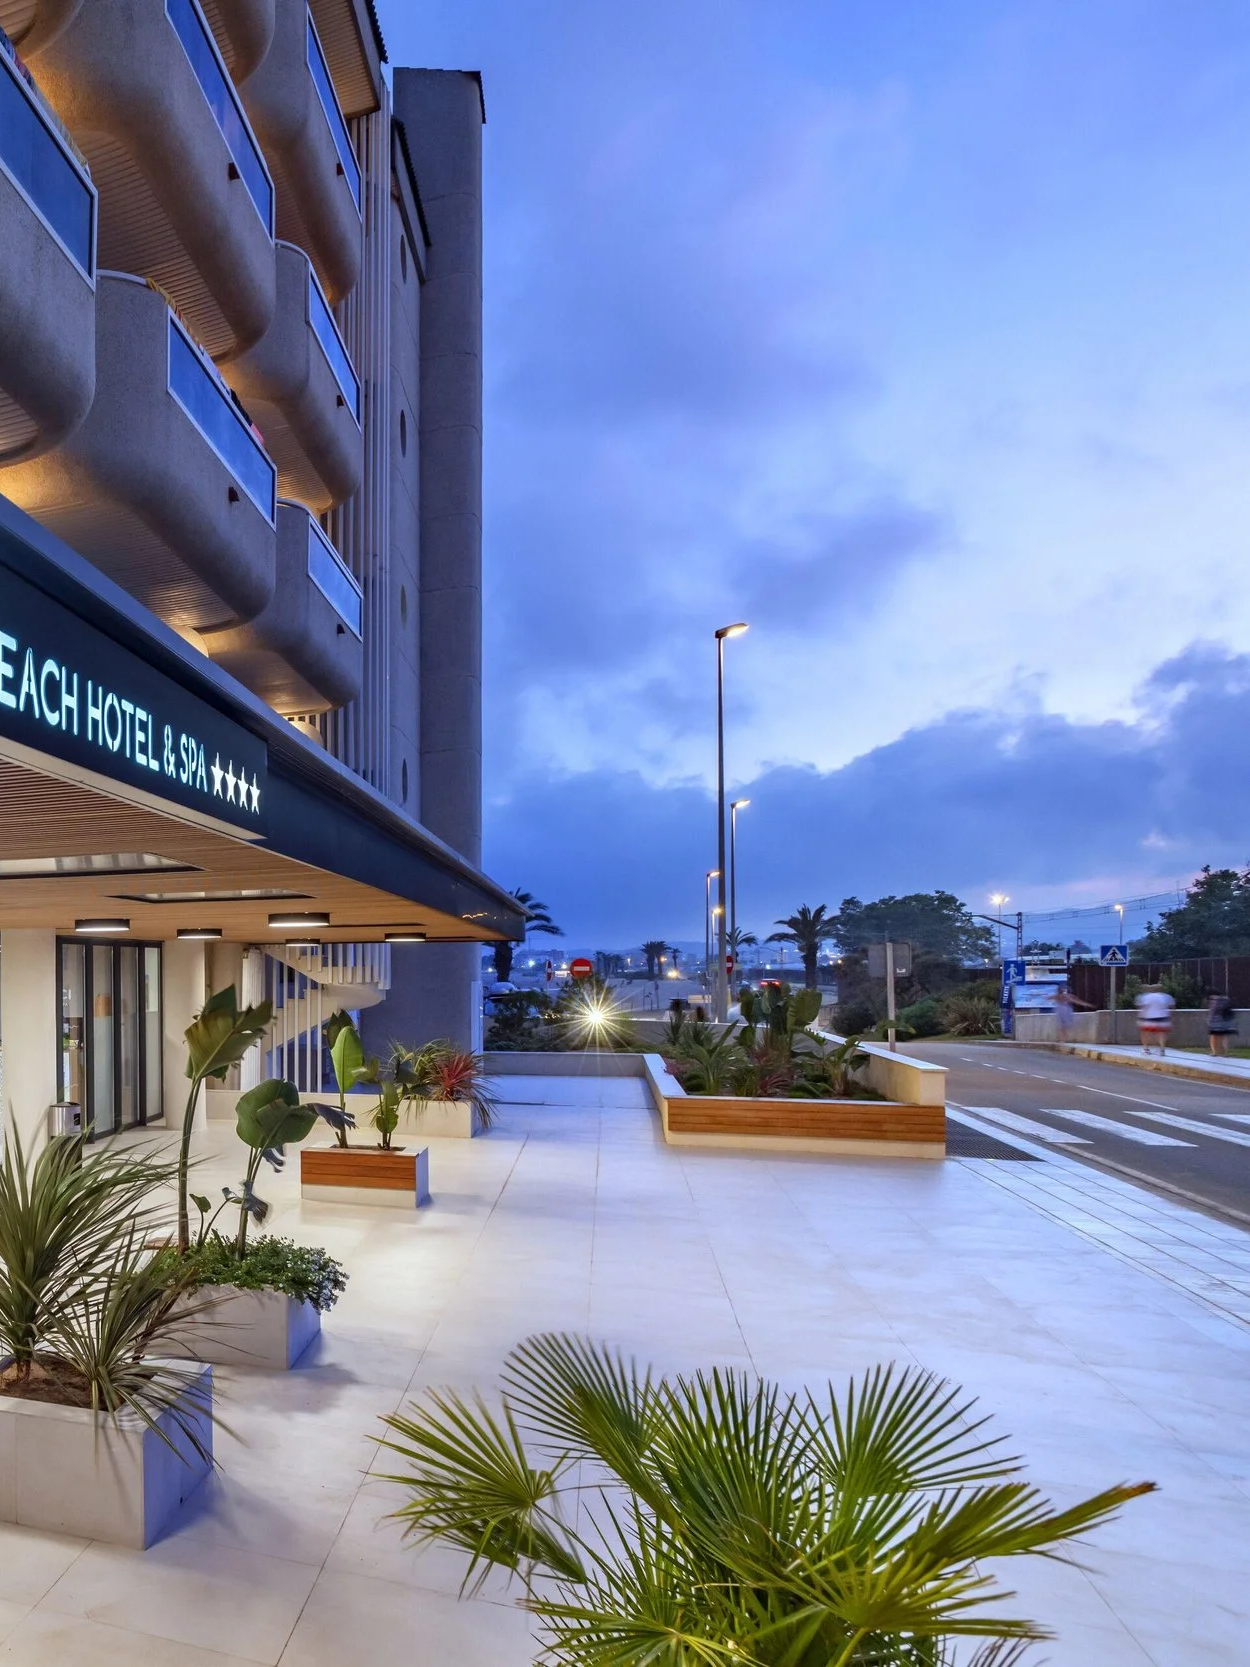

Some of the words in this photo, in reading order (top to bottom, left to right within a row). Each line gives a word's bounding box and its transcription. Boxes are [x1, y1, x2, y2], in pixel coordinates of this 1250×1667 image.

[86, 679, 160, 773] HOTEL
[163, 724, 177, 780] &
[179, 732, 208, 793] SPA
